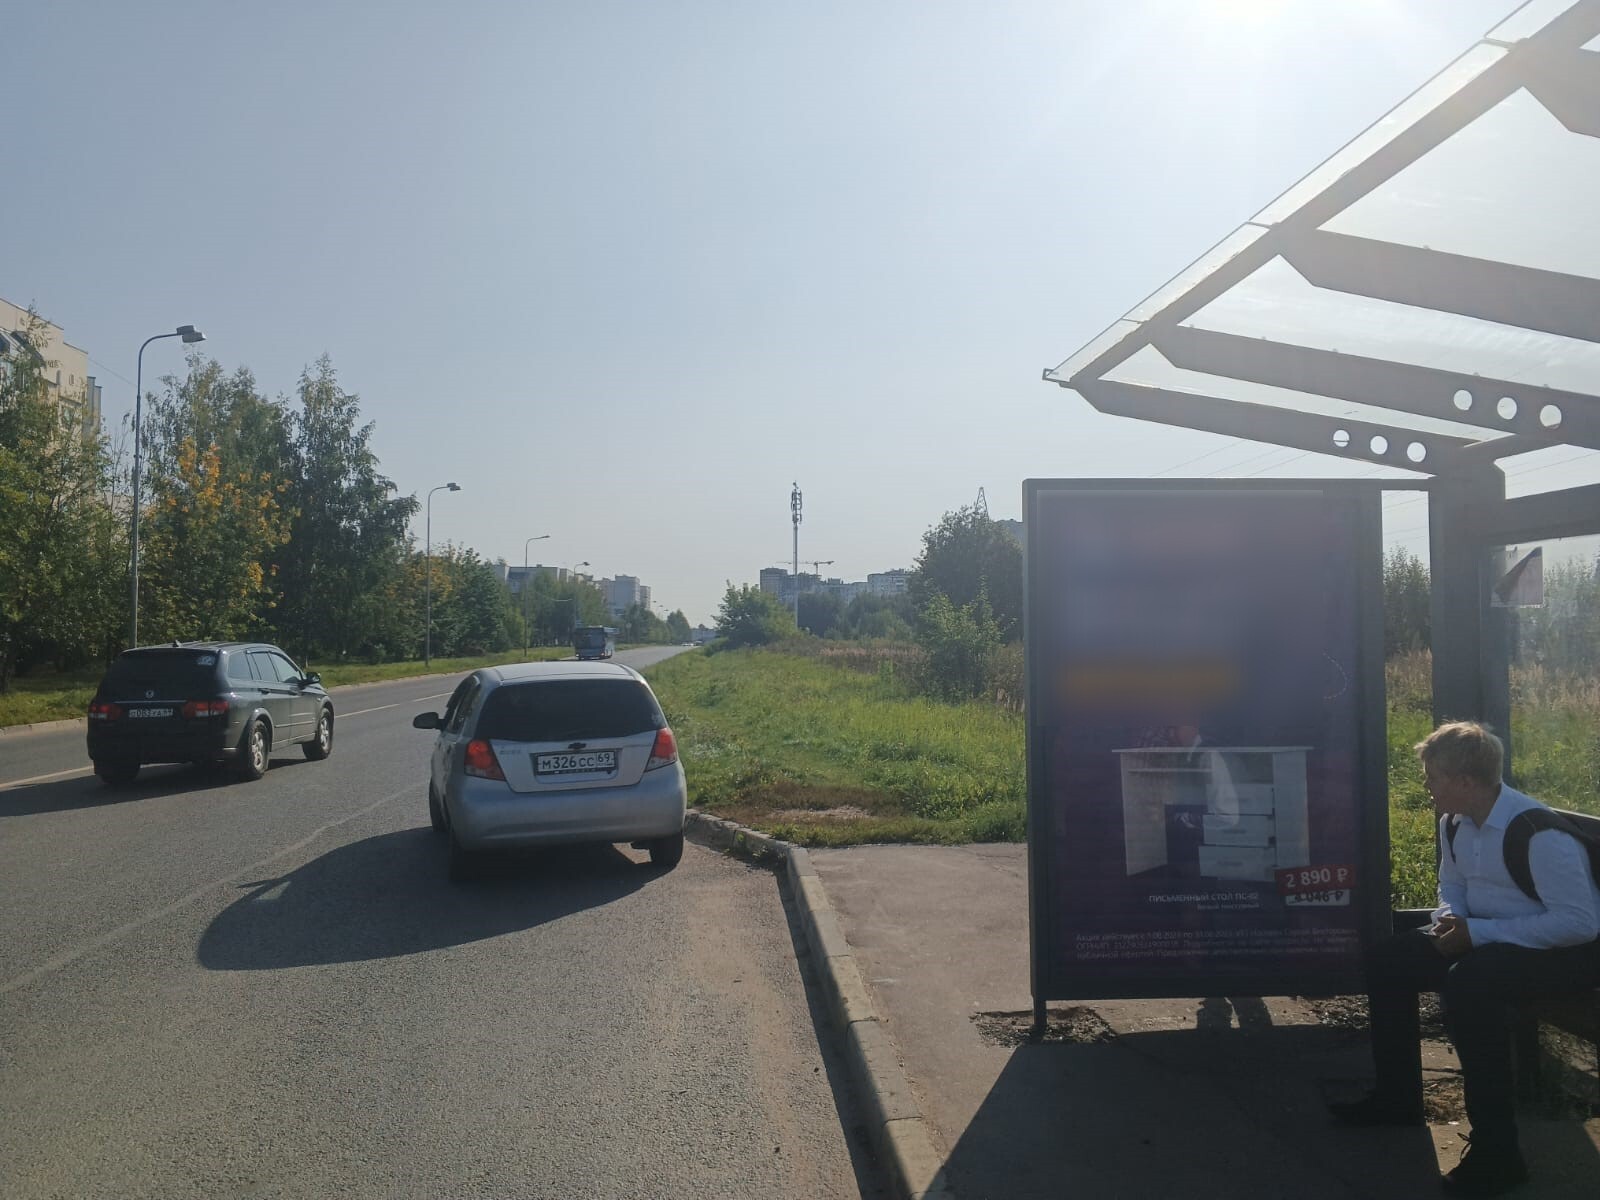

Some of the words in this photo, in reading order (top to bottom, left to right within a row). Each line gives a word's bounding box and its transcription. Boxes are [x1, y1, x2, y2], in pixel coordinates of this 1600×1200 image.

[597, 752, 610, 763] 69
[1286, 874, 1296, 888] 2
[1300, 868, 1331, 885] 890
[1149, 893, 1209, 903] ПИСЬМЕННЫЙ
[1211, 891, 1233, 901] СТОЛ
